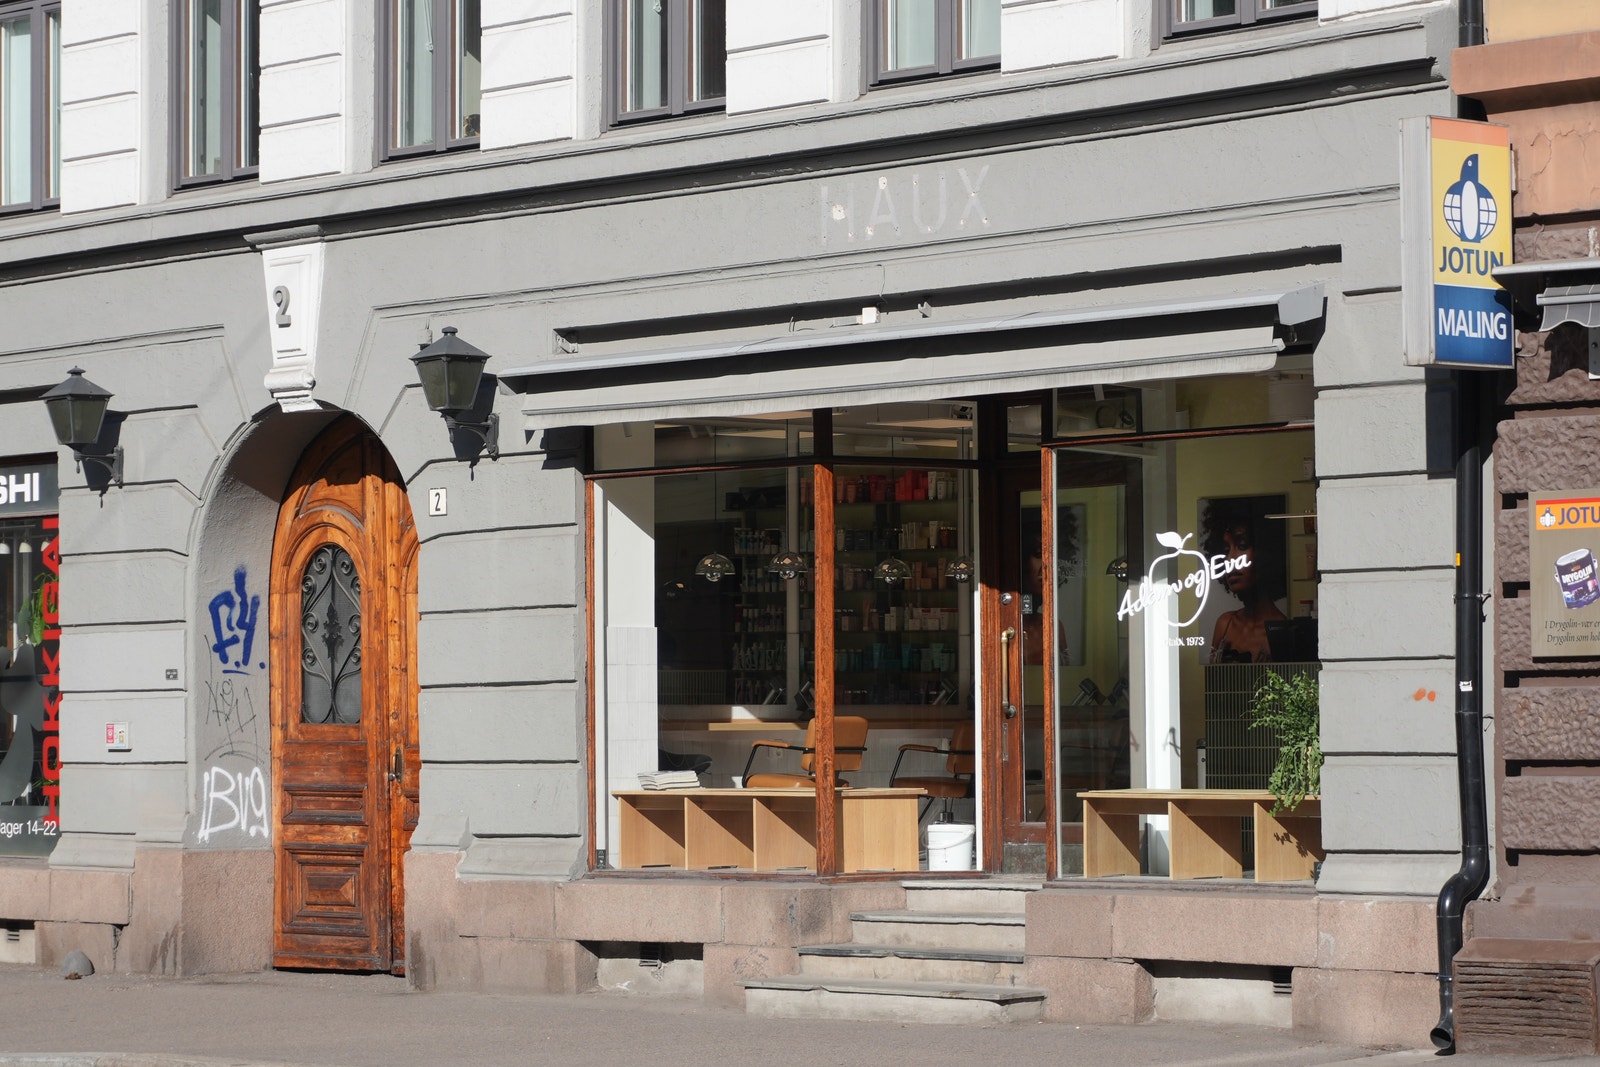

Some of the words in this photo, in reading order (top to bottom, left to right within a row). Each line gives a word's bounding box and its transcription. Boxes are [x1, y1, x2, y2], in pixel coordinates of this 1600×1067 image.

[1439, 246, 1504, 276] JOTUN
[273, 286, 292, 328] 2
[1438, 308, 1507, 340] MALING
[434, 492, 442, 512] 2
[1184, 569, 1206, 598] og
[1209, 553, 1252, 580] Eva
[1561, 564, 1593, 584] DRYGOLIN
[1186, 636, 1205, 647] 1973
[1546, 632, 1575, 646] Drygolin
[1575, 634, 1589, 642] som
[0, 822, 23, 838] ager
